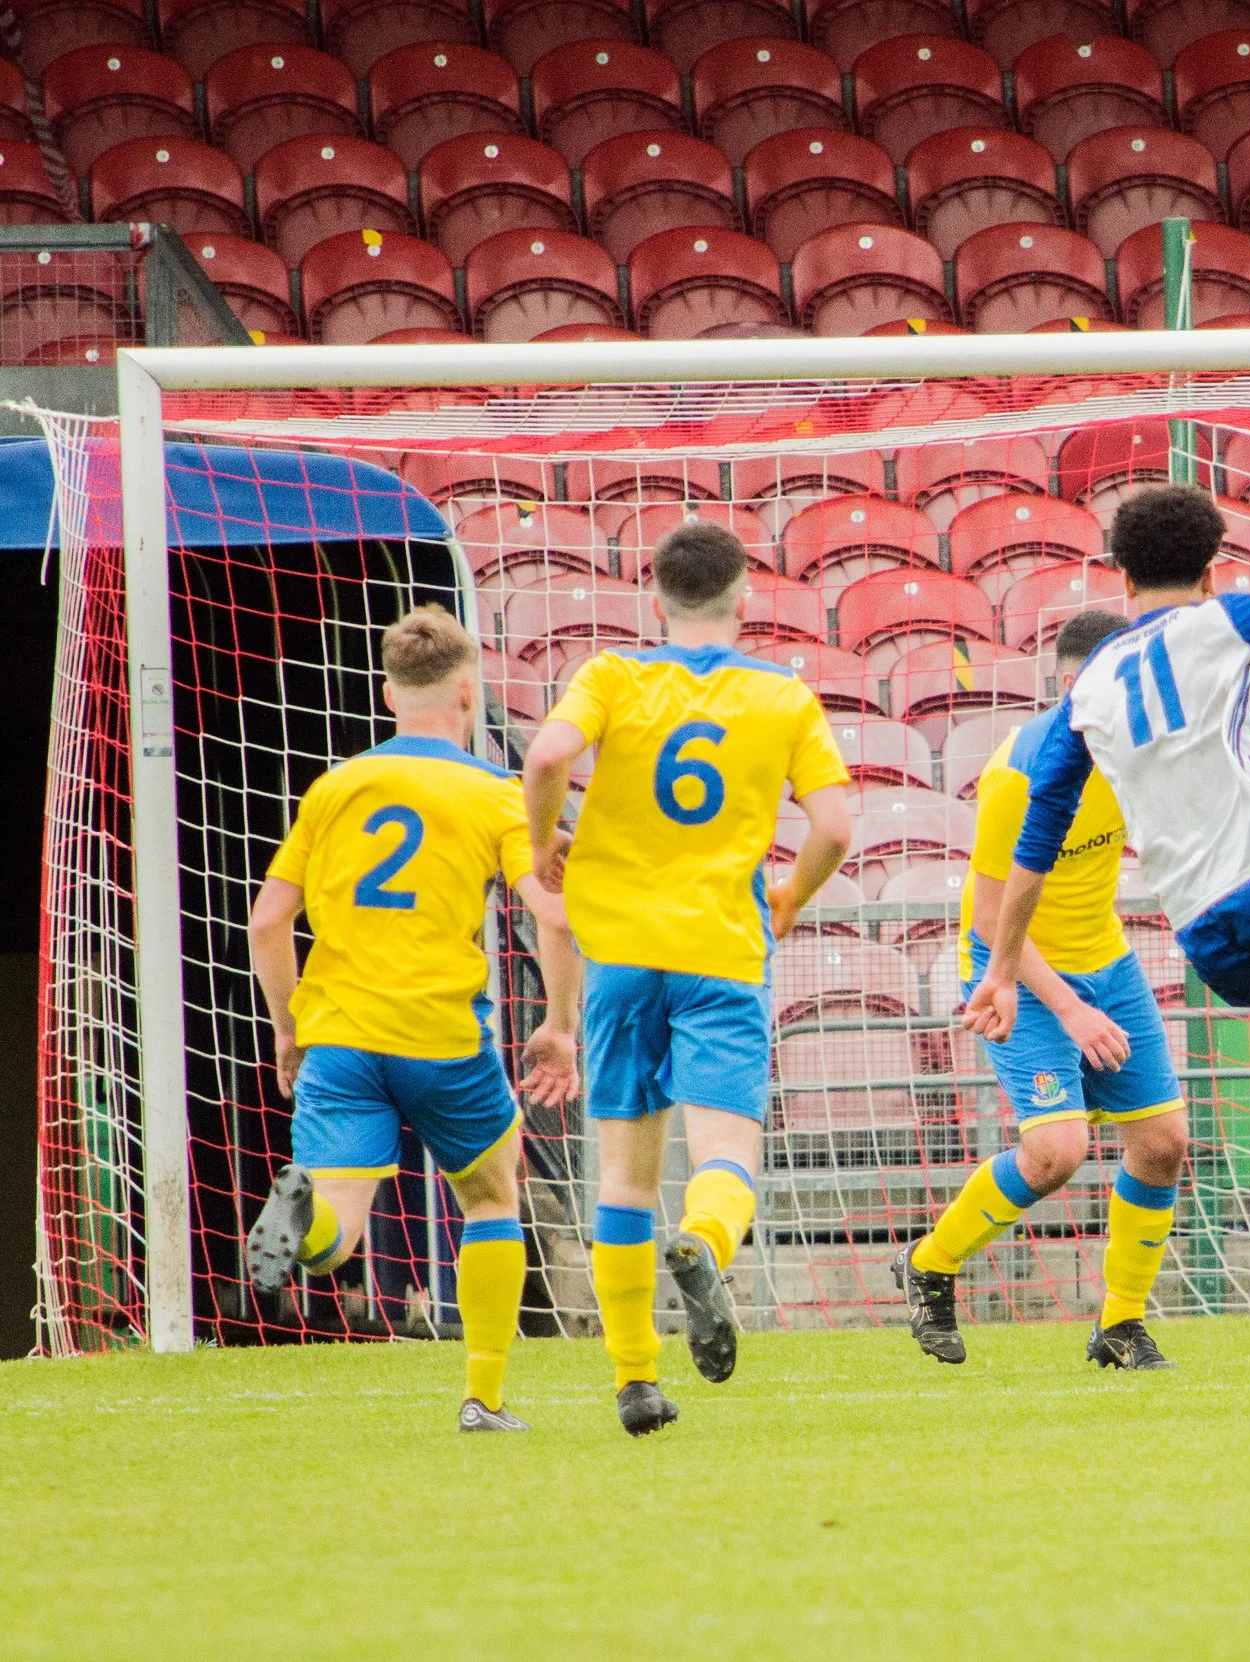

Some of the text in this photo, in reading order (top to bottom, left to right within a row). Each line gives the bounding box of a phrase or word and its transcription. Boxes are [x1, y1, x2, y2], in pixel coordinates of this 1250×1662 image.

[1114, 631, 1187, 748] 11
[654, 721, 727, 826] 6
[354, 804, 425, 911] 2
